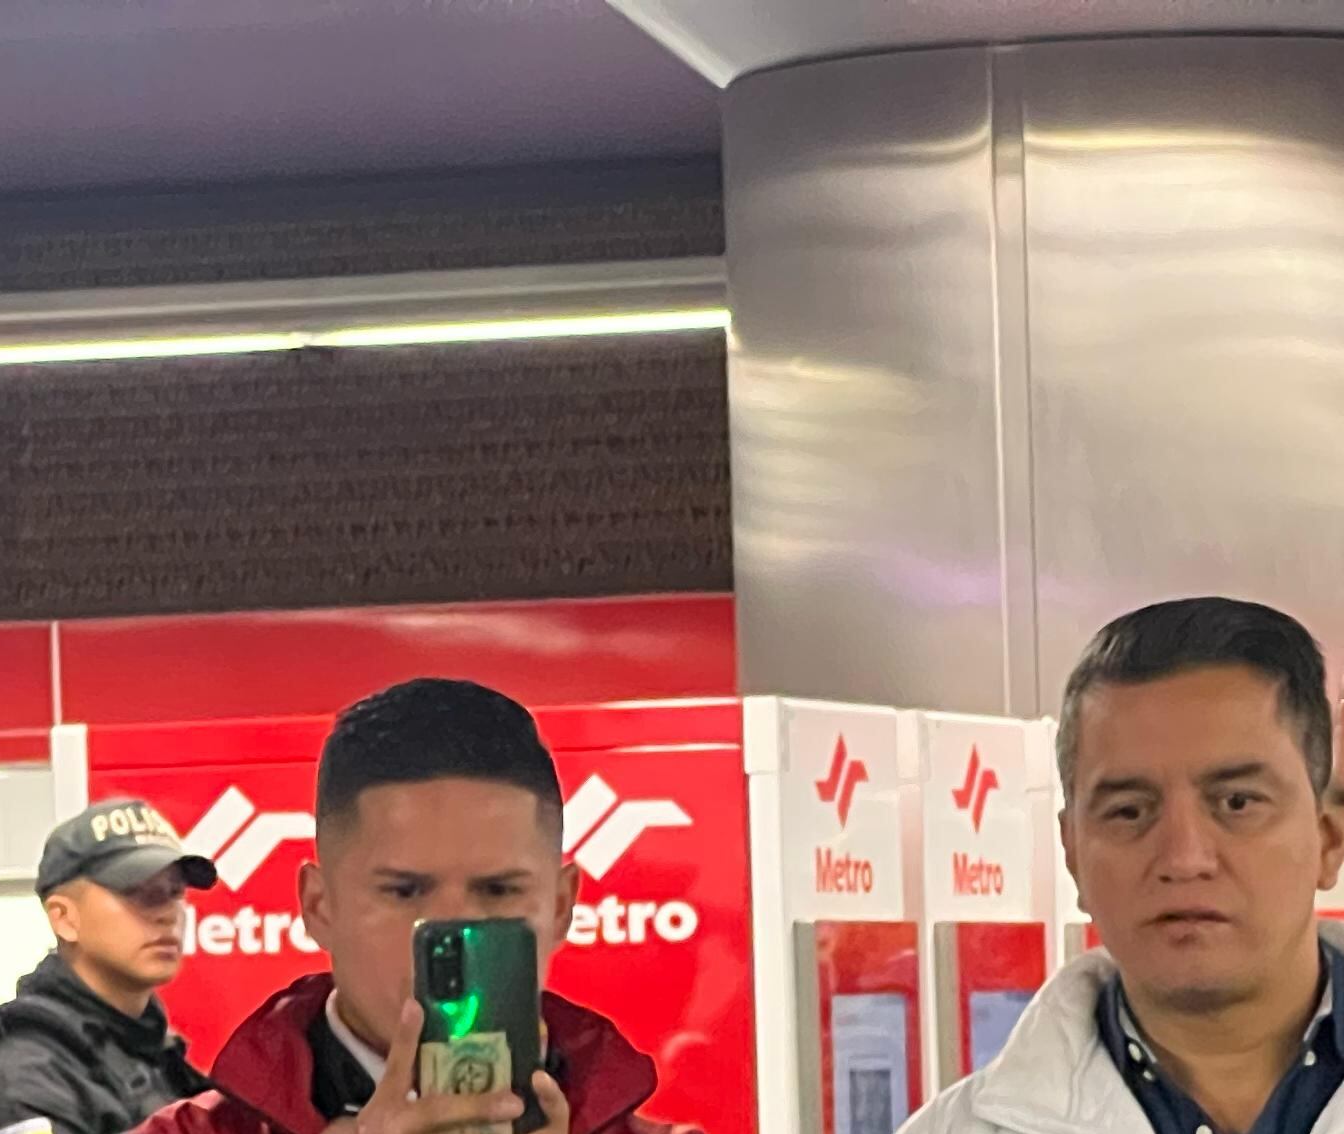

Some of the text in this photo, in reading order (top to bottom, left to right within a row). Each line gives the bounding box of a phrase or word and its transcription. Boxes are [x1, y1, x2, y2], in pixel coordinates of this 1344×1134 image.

[815, 847, 873, 893] Metro
[953, 852, 1004, 896] Metro
[566, 895, 698, 945] etro
